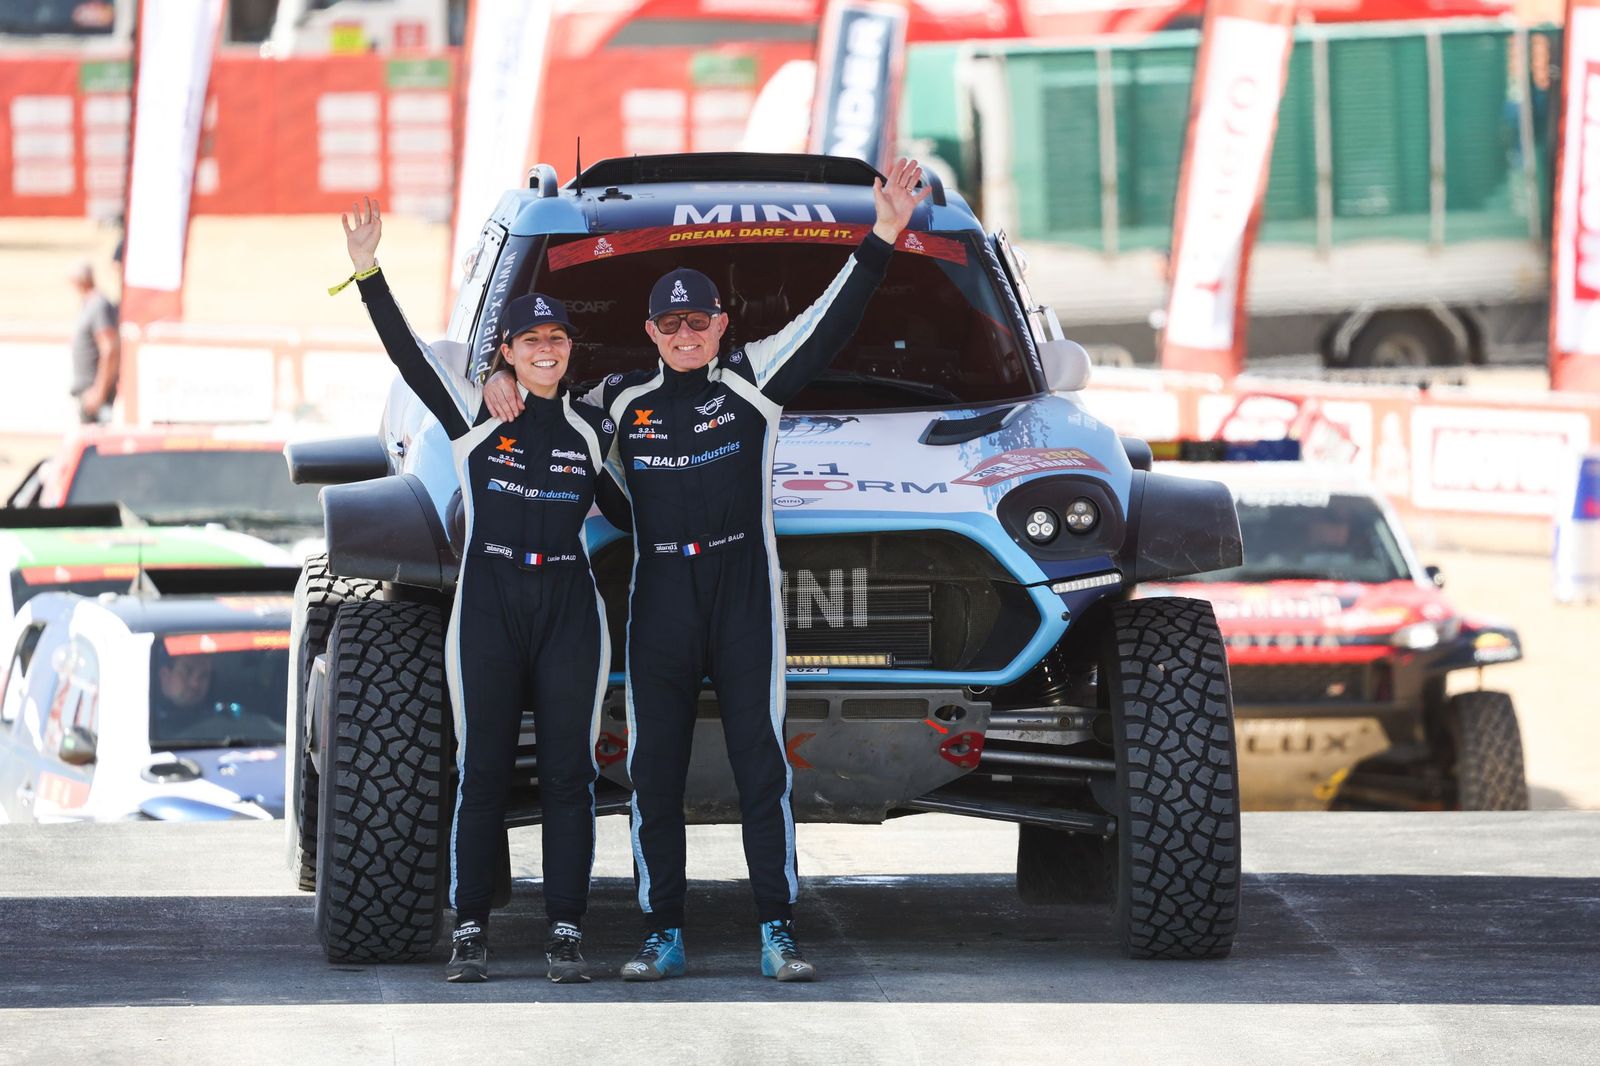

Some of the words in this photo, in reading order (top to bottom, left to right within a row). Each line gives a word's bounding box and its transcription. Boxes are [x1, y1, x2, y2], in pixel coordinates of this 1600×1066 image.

[673, 204, 836, 226] MINI
[669, 229, 735, 241] DREAM.
[739, 228, 788, 237] DARE.
[793, 228, 830, 237] LIVE
[834, 230, 852, 238] IT.
[691, 441, 740, 464] Industries
[539, 490, 579, 500] Industries
[708, 538, 727, 547] Lionel
[728, 532, 745, 542] BAUD
